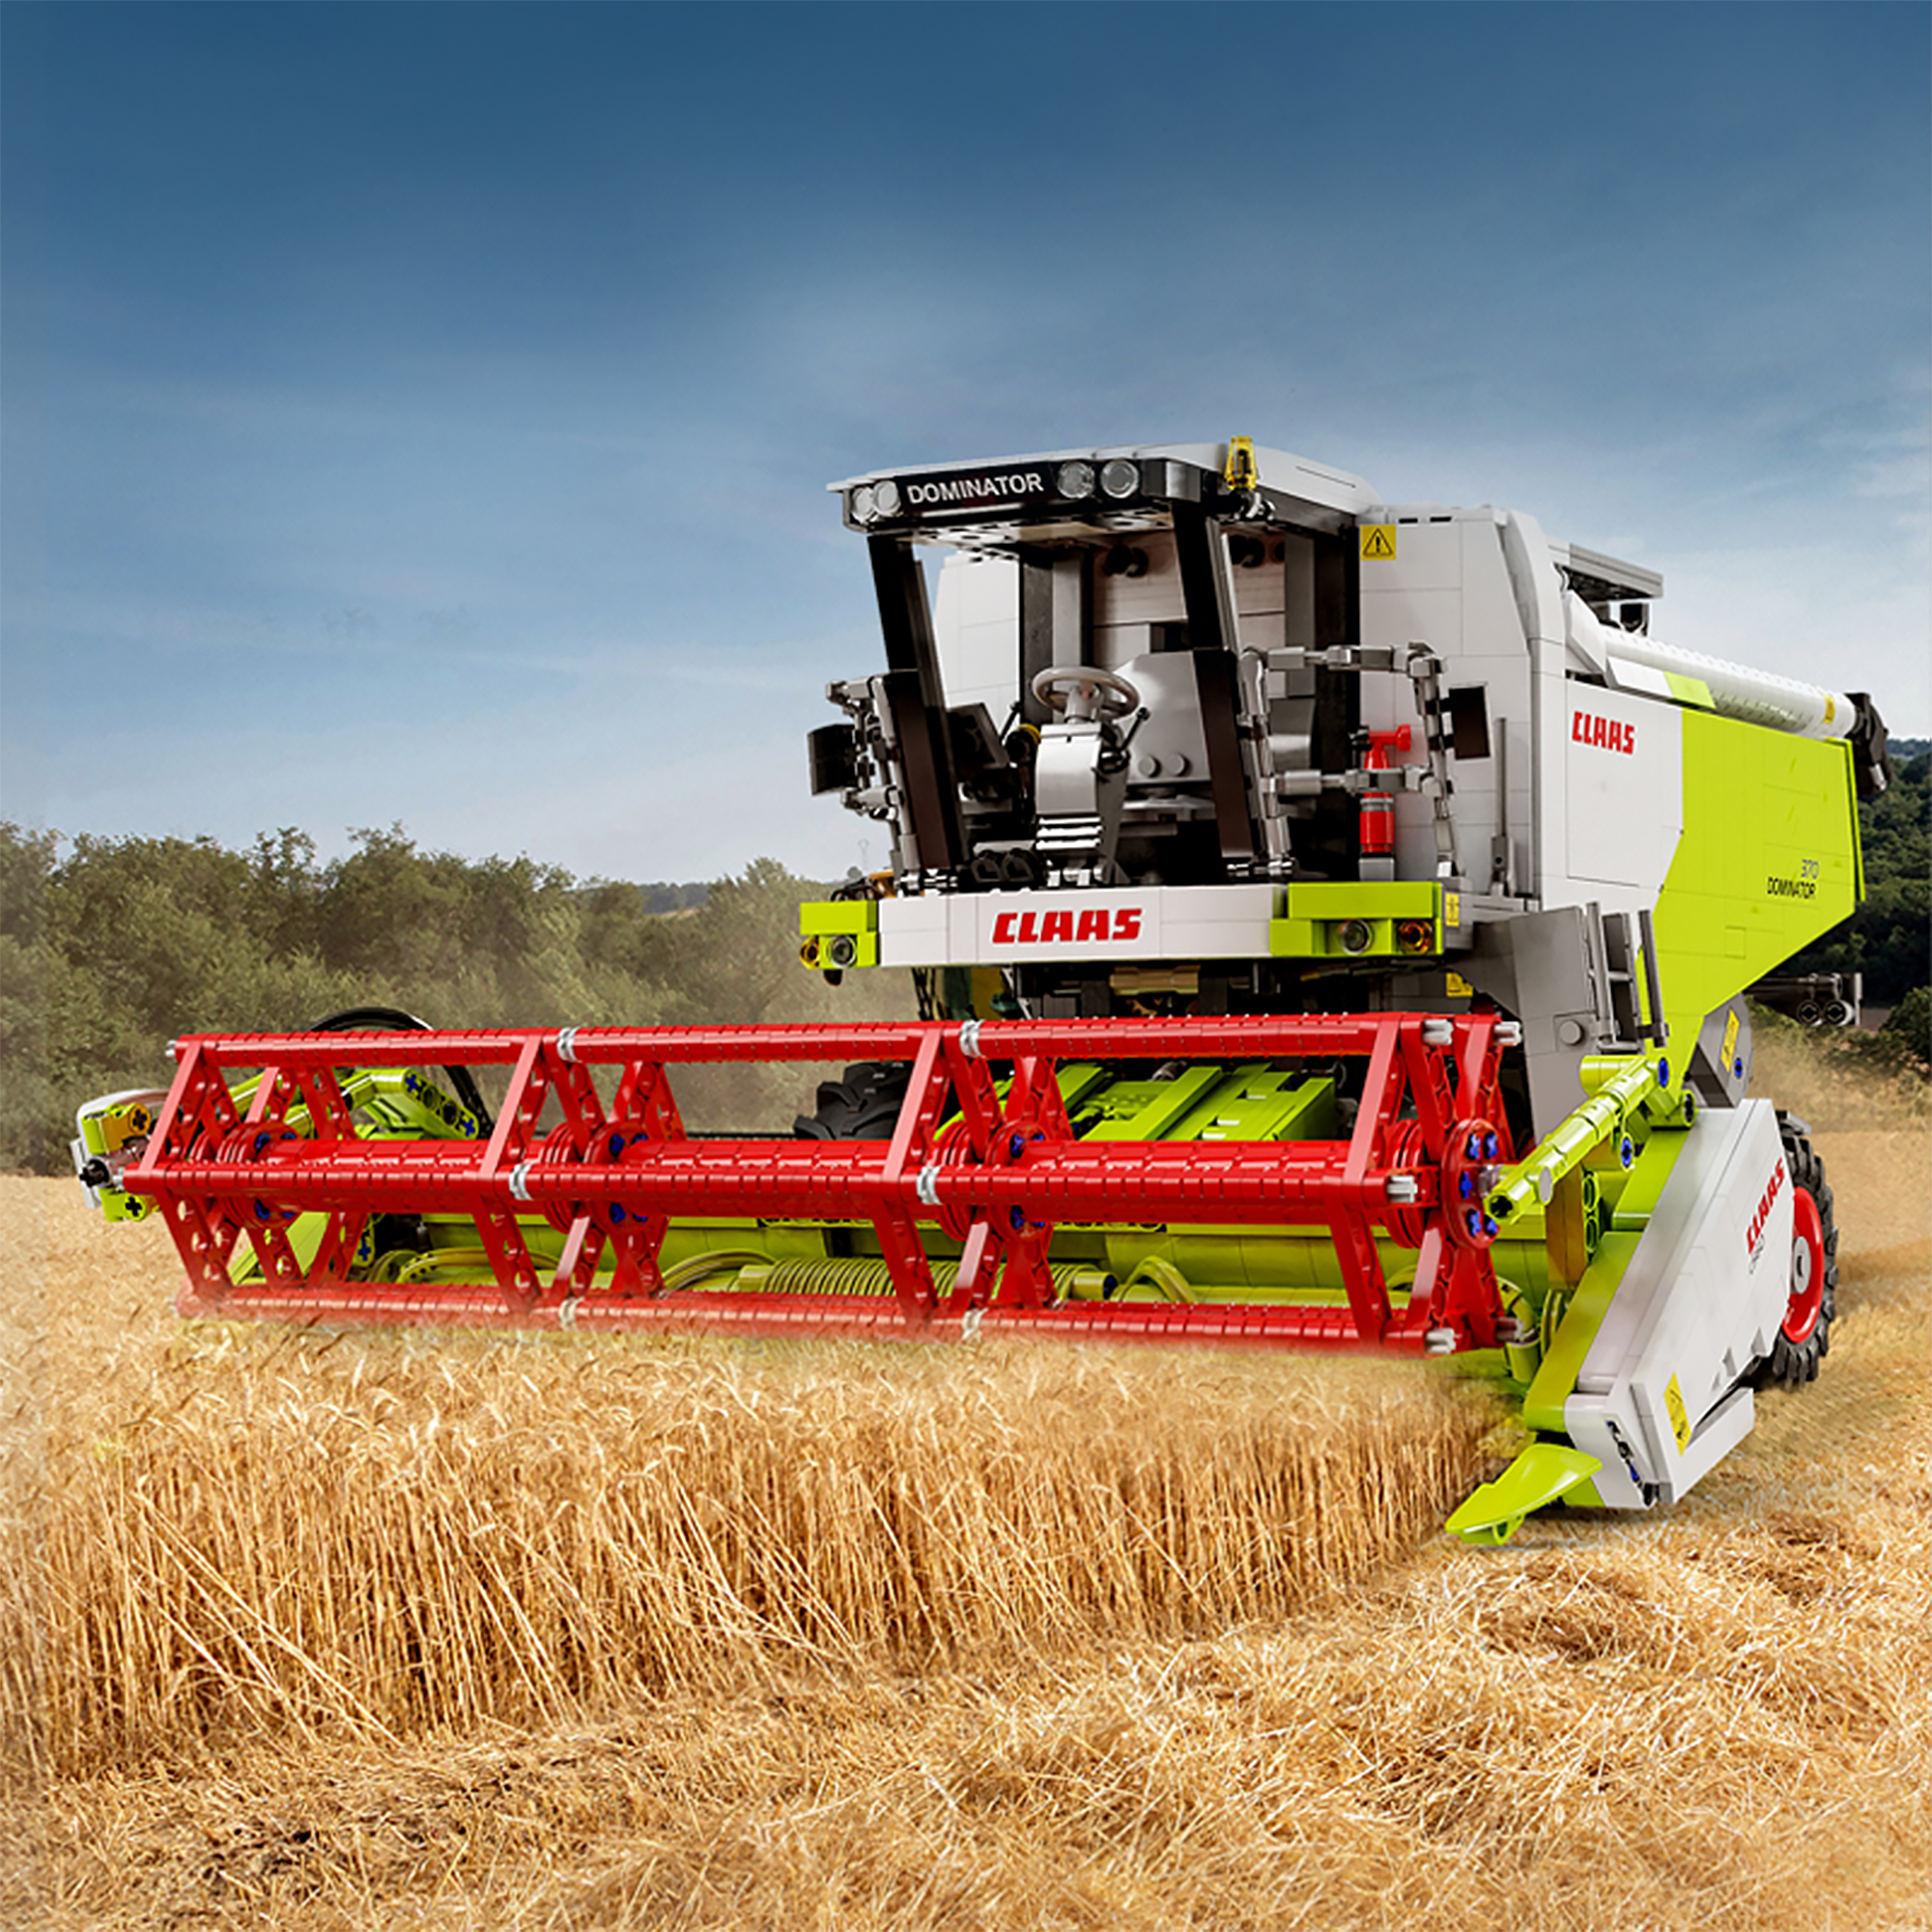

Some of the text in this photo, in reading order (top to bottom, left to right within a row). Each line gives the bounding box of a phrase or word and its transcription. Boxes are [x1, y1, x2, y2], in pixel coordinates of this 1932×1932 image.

[906, 472, 1044, 504] DOMINATOR
[1572, 710, 1635, 755] CLAAS
[992, 908, 1142, 944] CLAAS
[1747, 1157, 1784, 1255] CLAAS
